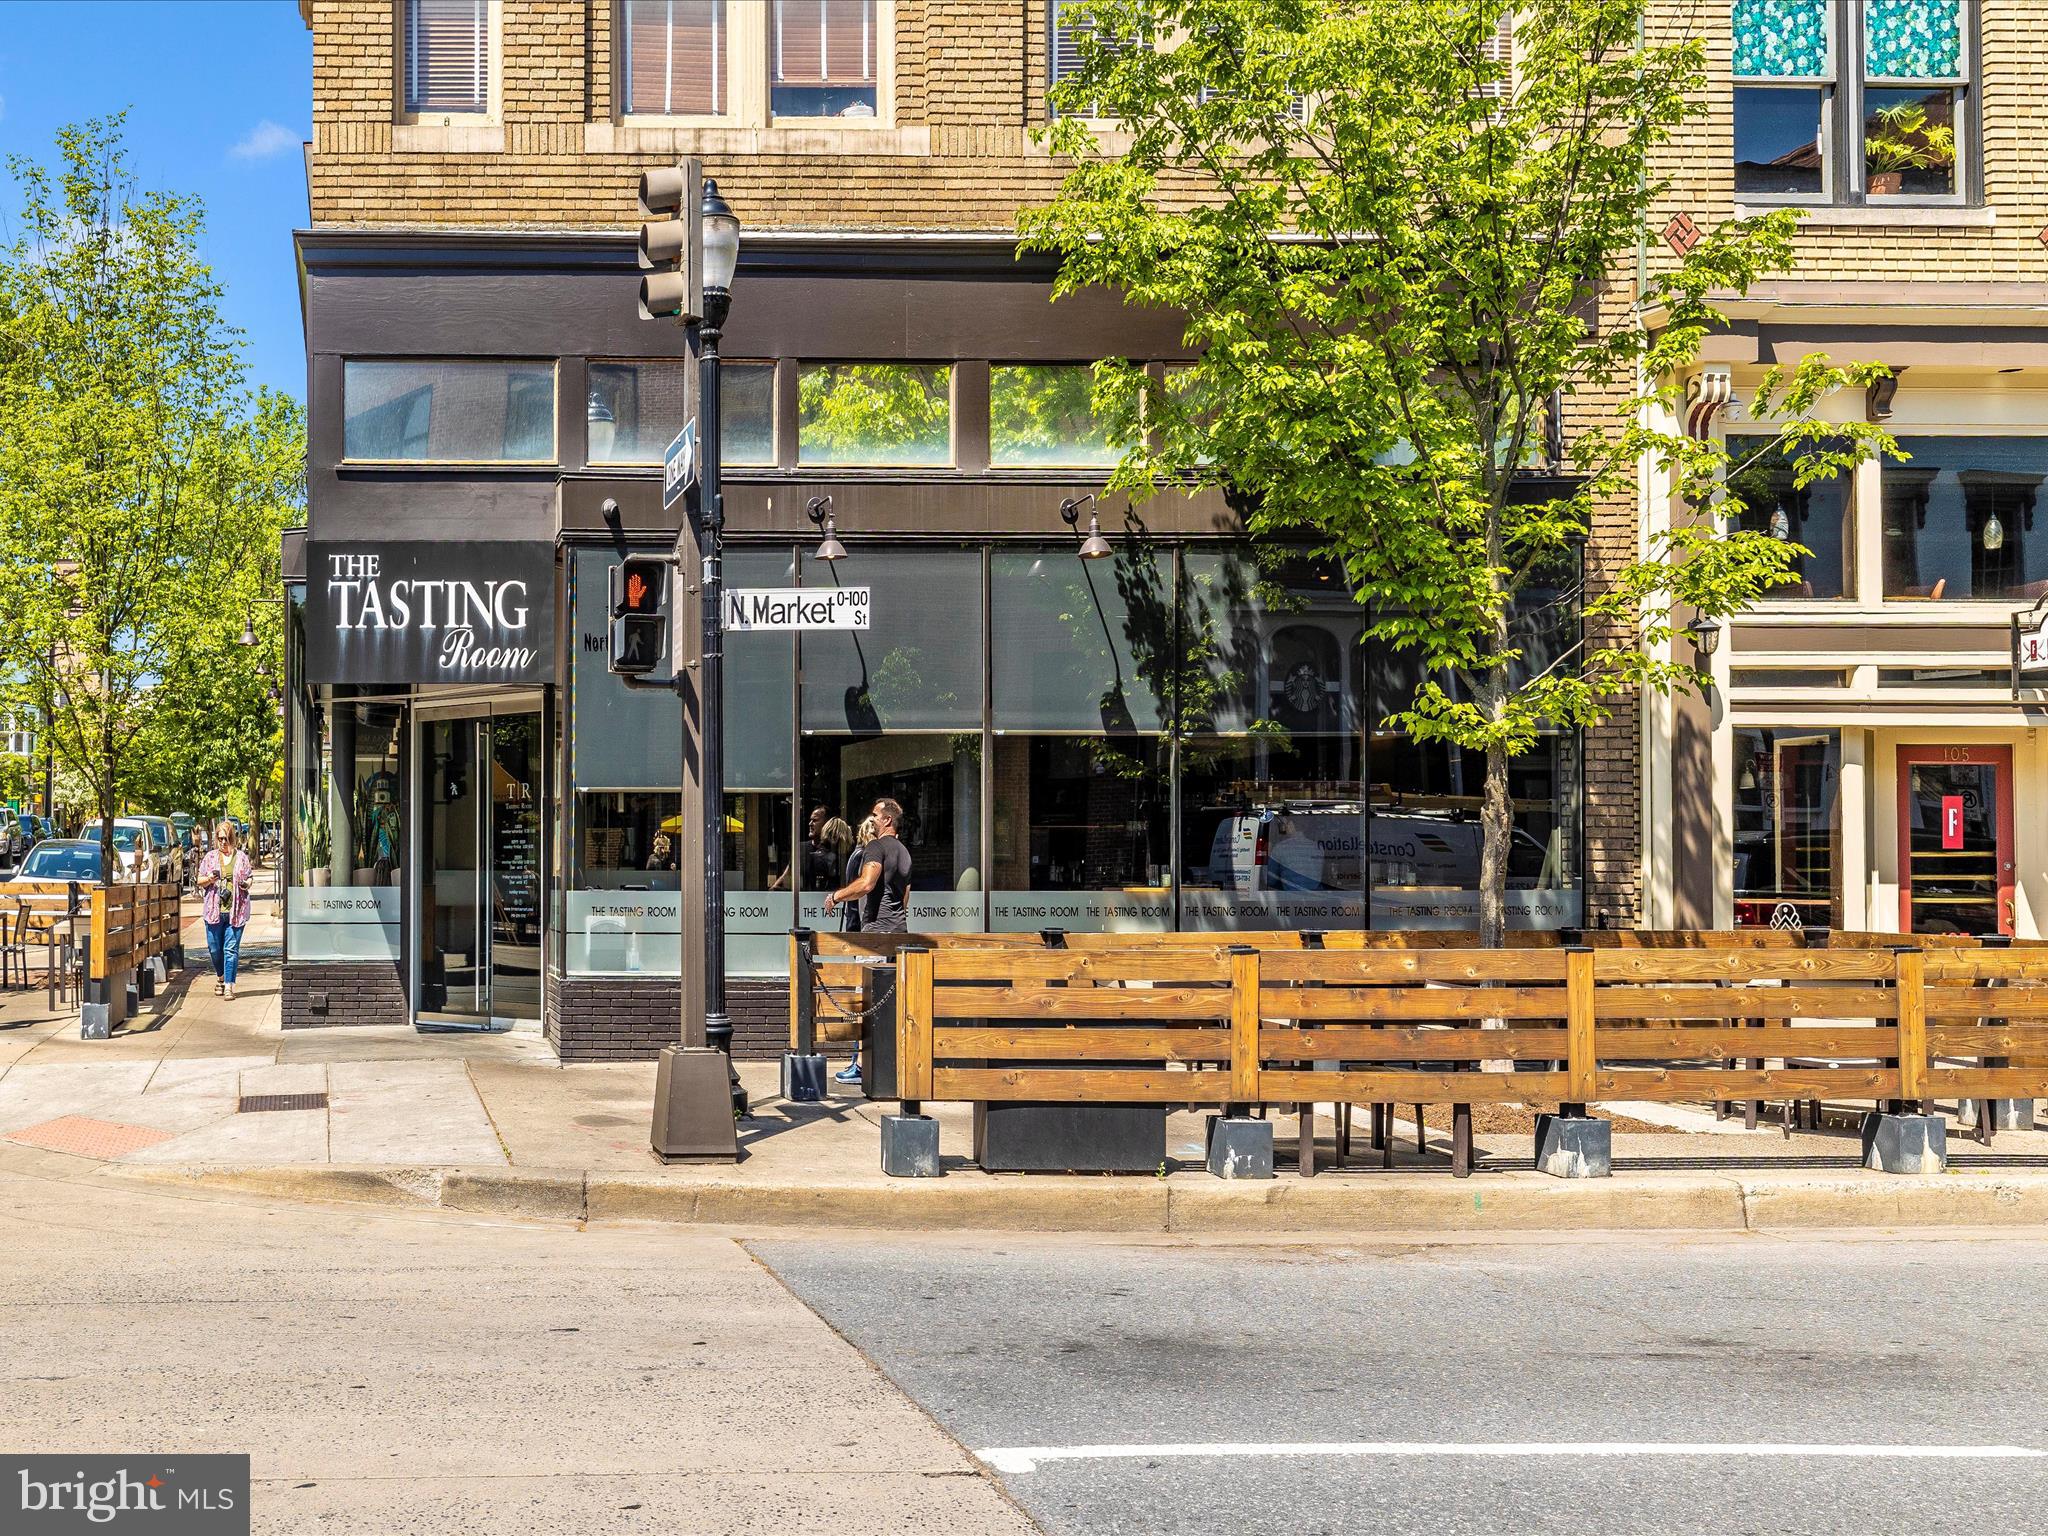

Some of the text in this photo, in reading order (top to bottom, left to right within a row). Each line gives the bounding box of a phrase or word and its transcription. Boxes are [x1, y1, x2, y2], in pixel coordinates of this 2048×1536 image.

[328, 554, 381, 577] THE
[328, 578, 529, 630] TASTING
[837, 591, 868, 606] 0-100
[731, 596, 835, 624] N. Market
[854, 610, 867, 625] St
[438, 628, 538, 669] Room
[1943, 746, 1970, 762] 105
[1948, 808, 1958, 837] F
[308, 900, 382, 910] THE TASTING ROOM
[592, 906, 677, 917] THE TASTING ROOM
[739, 907, 769, 918] ROOM
[803, 907, 817, 918] THE
[913, 906, 947, 918] TASTING
[950, 906, 980, 918] ROOM
[995, 906, 1079, 917] THE TASTING ROOM
[1086, 906, 1170, 917] THE TASTING ROOM
[1185, 906, 1269, 917] THE TASTING ROOM
[1276, 906, 1360, 917] THE TASTING ROOM
[1389, 906, 1473, 917] THE TASTING ROOM
